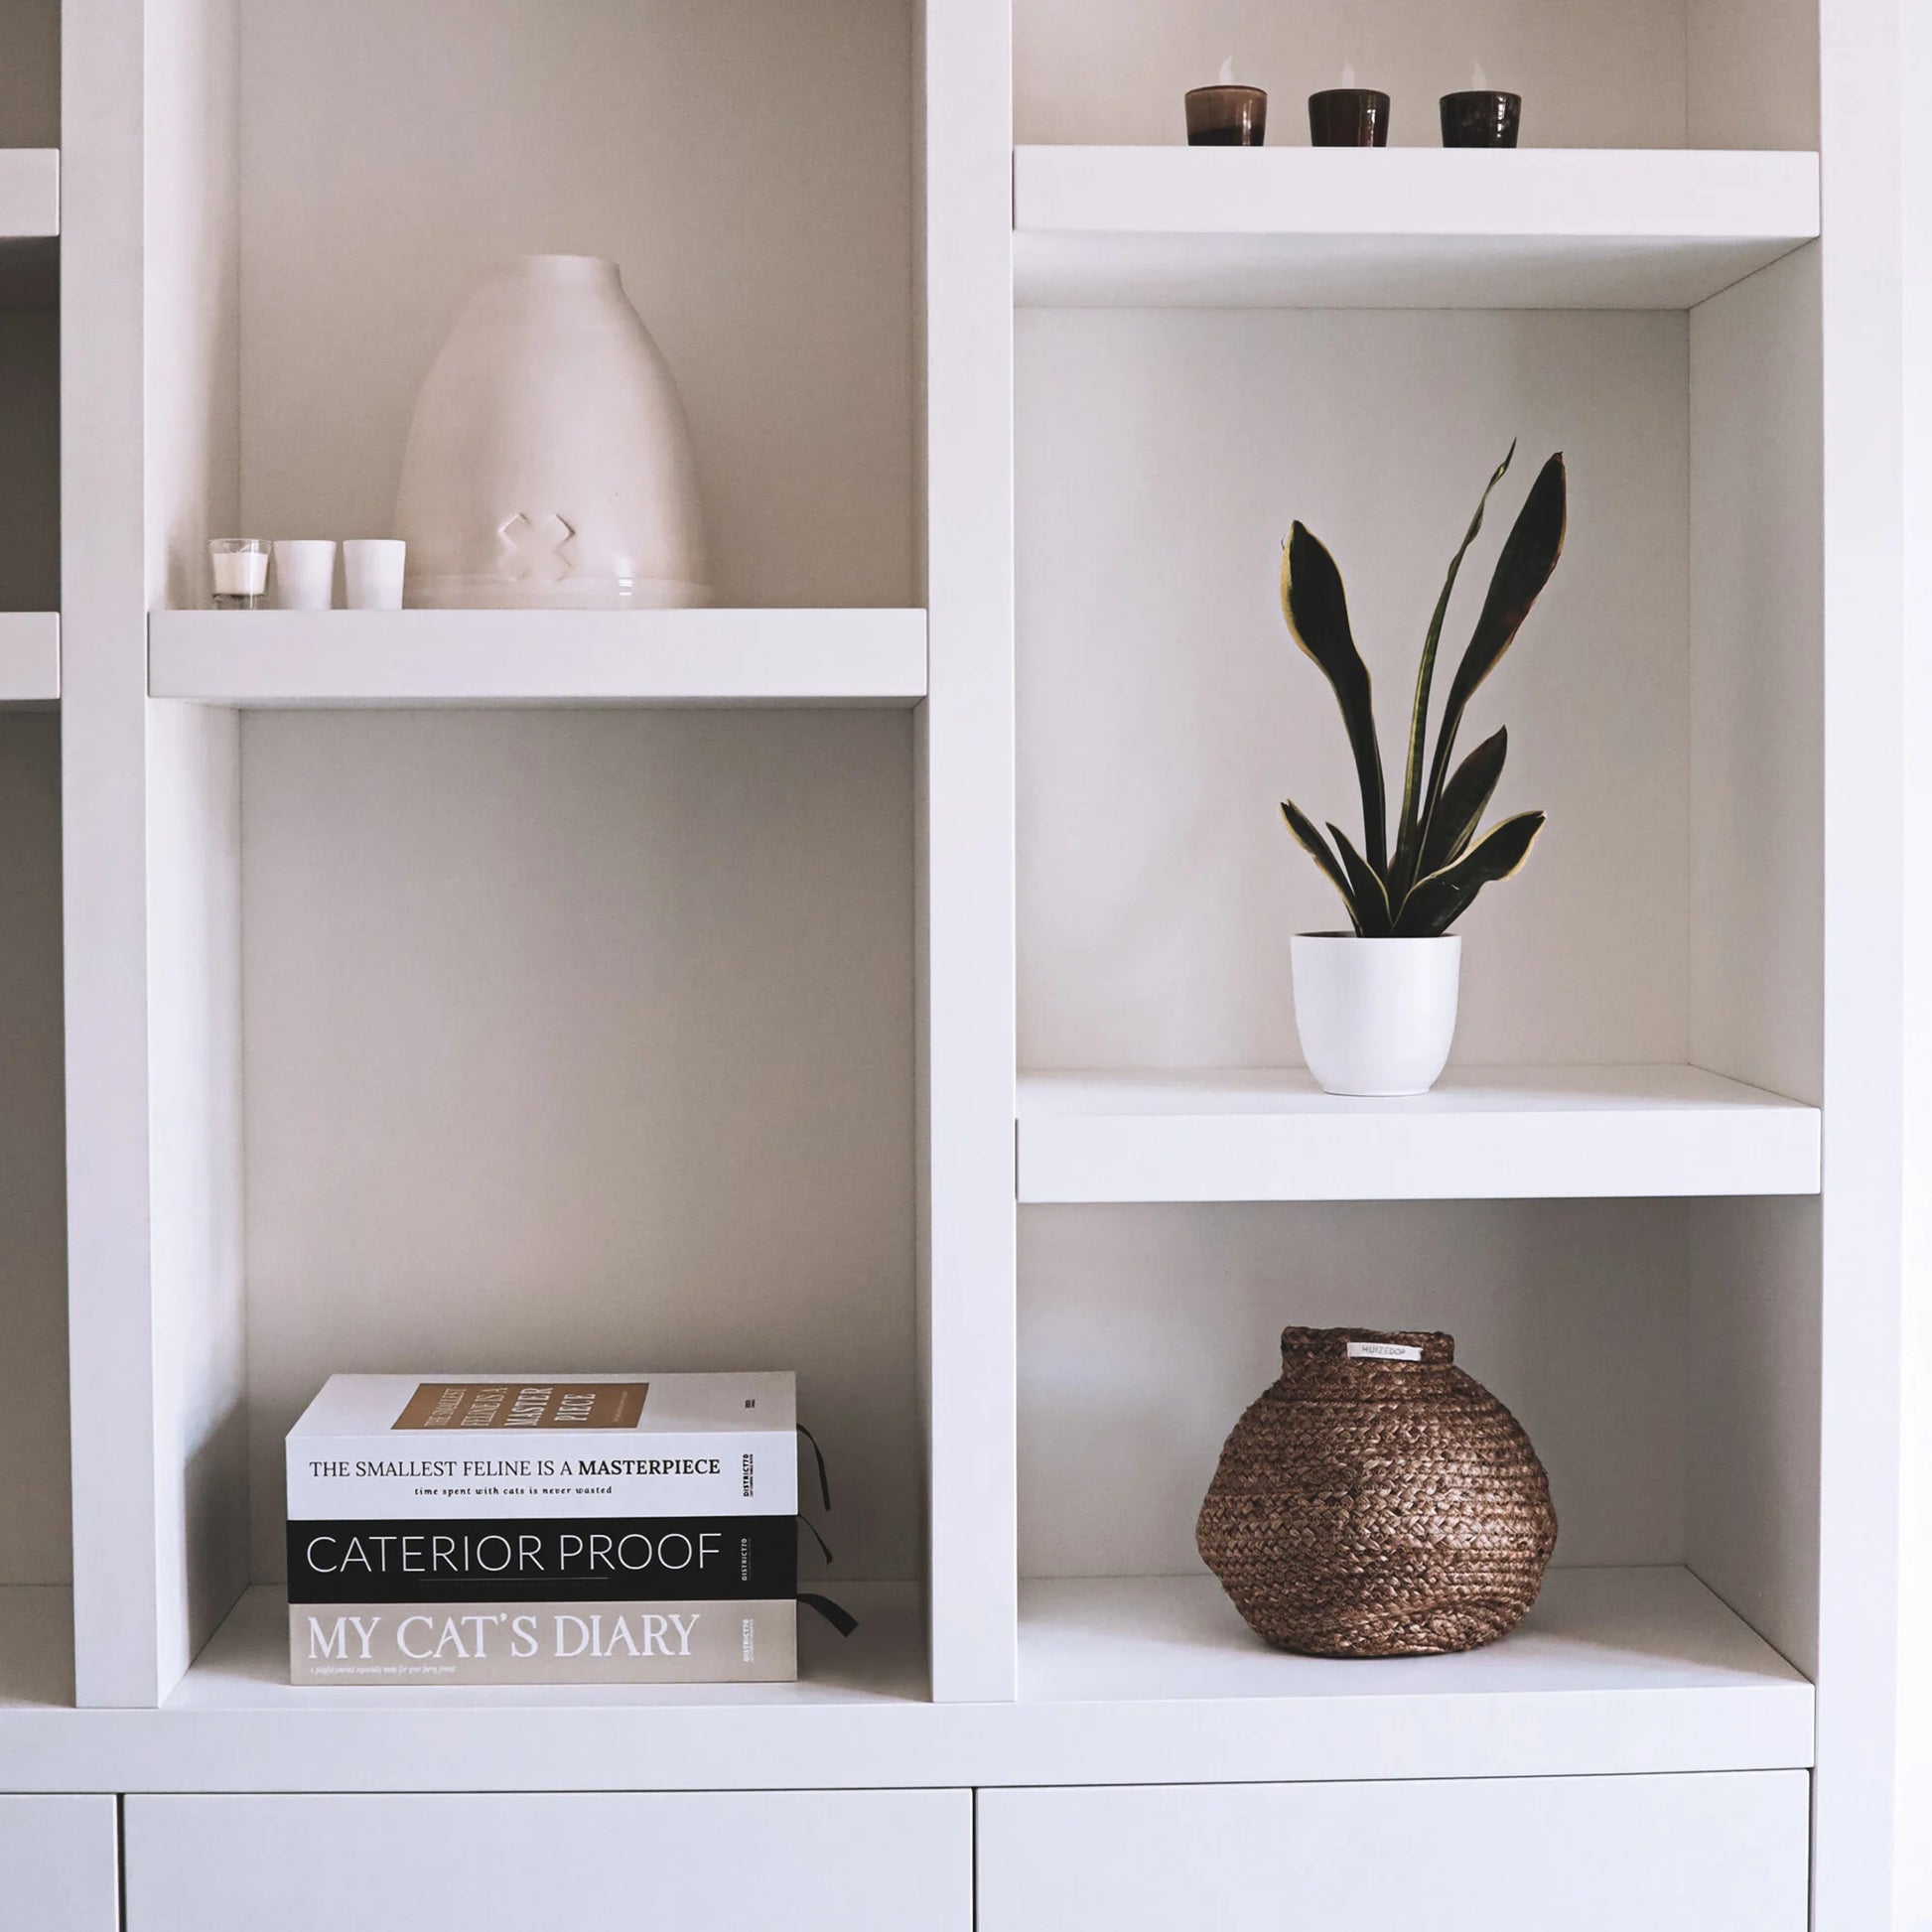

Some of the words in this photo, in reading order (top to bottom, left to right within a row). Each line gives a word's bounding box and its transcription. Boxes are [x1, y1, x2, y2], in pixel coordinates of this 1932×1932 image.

[504, 1387, 553, 1426] MASTER
[554, 1393, 597, 1421] PIECE
[309, 1461, 349, 1477] THE
[355, 1460, 458, 1477] SMALLEST
[463, 1460, 532, 1476] FELINE
[537, 1460, 555, 1476] IS
[560, 1460, 573, 1476] A
[578, 1458, 721, 1475] MASTERPIECE
[442, 1487, 471, 1497] spent
[475, 1486, 499, 1495] with
[502, 1486, 524, 1495] cats
[575, 1485, 613, 1494] wasted
[306, 1534, 544, 1573] CATERIOR
[560, 1532, 722, 1571] PROOF
[308, 1616, 381, 1659] MY
[396, 1612, 538, 1658] CAT'S
[554, 1613, 700, 1657] DIARY
